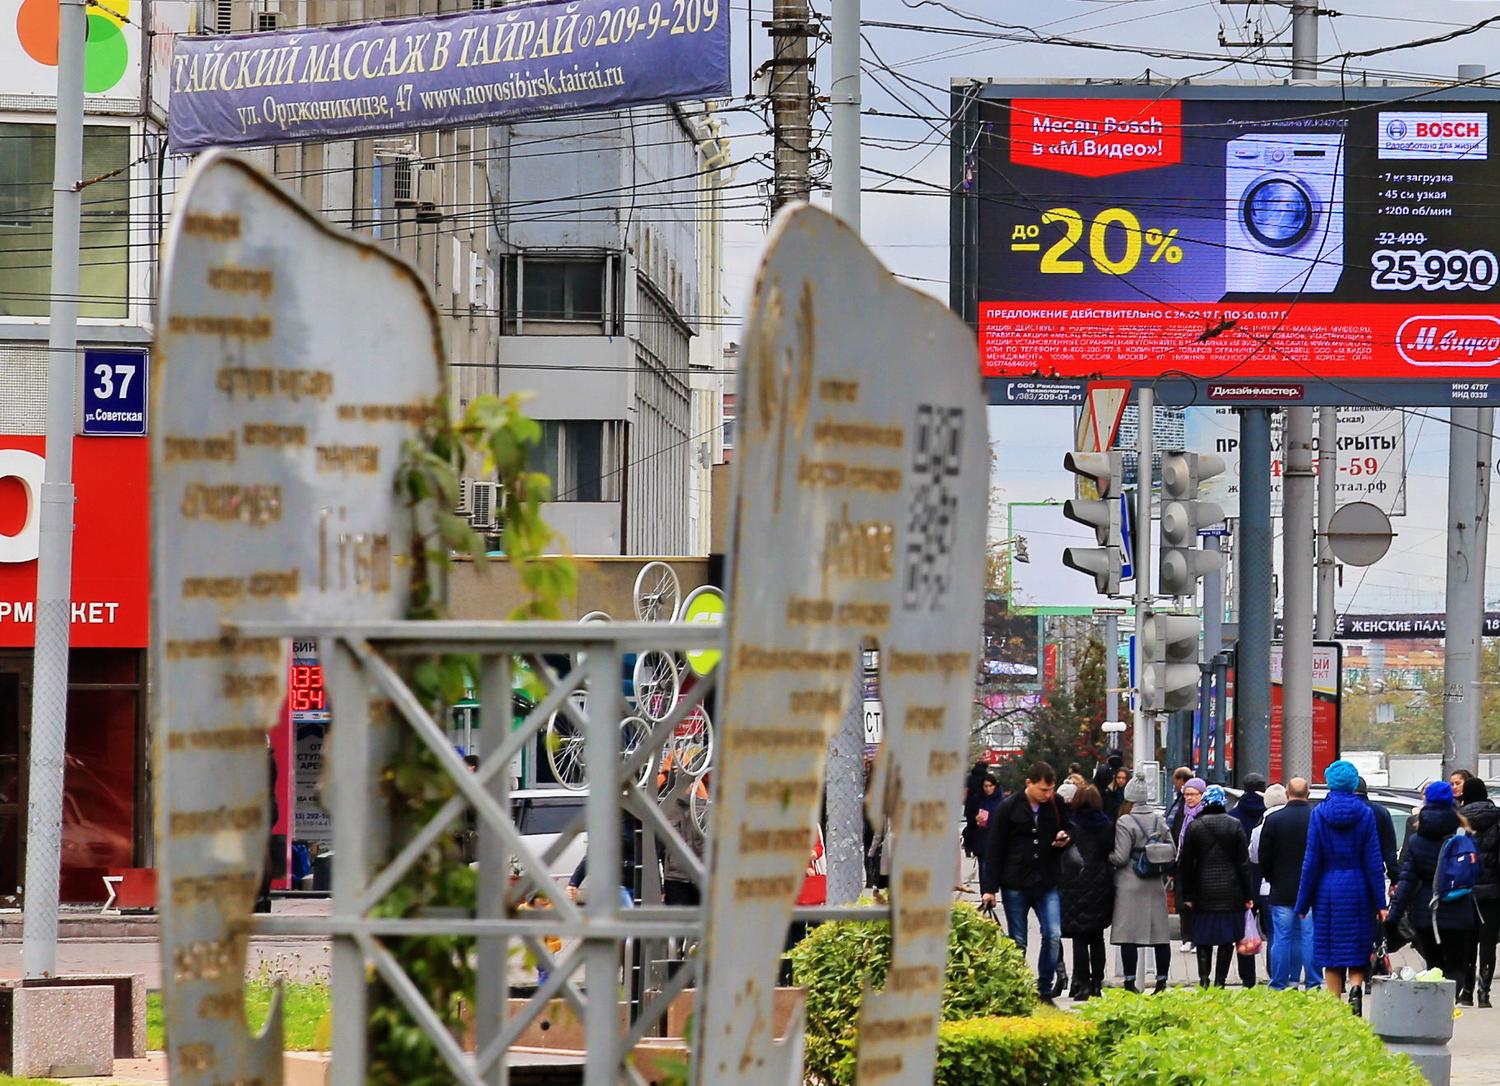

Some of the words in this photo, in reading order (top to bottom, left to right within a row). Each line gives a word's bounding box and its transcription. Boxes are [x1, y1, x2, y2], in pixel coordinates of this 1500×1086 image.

[174, 36, 302, 94] ТАЙСКИЙ
[299, 33, 431, 84] МАССАЖ
[429, 31, 452, 72] В
[457, 4, 581, 68] ТАЙРАЙ
[594, 0, 719, 47] 209-9-209
[237, 105, 261, 135] ул.
[263, 95, 394, 130] Орджоникидзе,
[395, 84, 413, 112] 47
[419, 61, 625, 110] www.novosibirsk.tairai.ru
[1033, 117, 1098, 136] Месяц
[1105, 116, 1162, 134] Bosch
[1416, 123, 1479, 137] BOSCH
[1048, 140, 1163, 158] «М.Видео»!
[1385, 173, 1391, 182] 7
[1406, 175, 1454, 185] загрузка
[1385, 190, 1398, 199] 45
[1417, 191, 1447, 201] узкая
[1412, 206, 1452, 216] об/мин
[1012, 224, 1039, 239] до
[987, 309, 1069, 319] ПРЕДЛОЖЕНИЕ
[1070, 307, 1162, 320] ДЕЙСТВИТЕЛЬНО
[1165, 310, 1172, 319] С
[93, 364, 136, 399] 37
[95, 408, 143, 421] Советская
[1352, 620, 1411, 632] ЖЕНСКИЕ
[1414, 620, 1446, 631] ПАЛЬ
